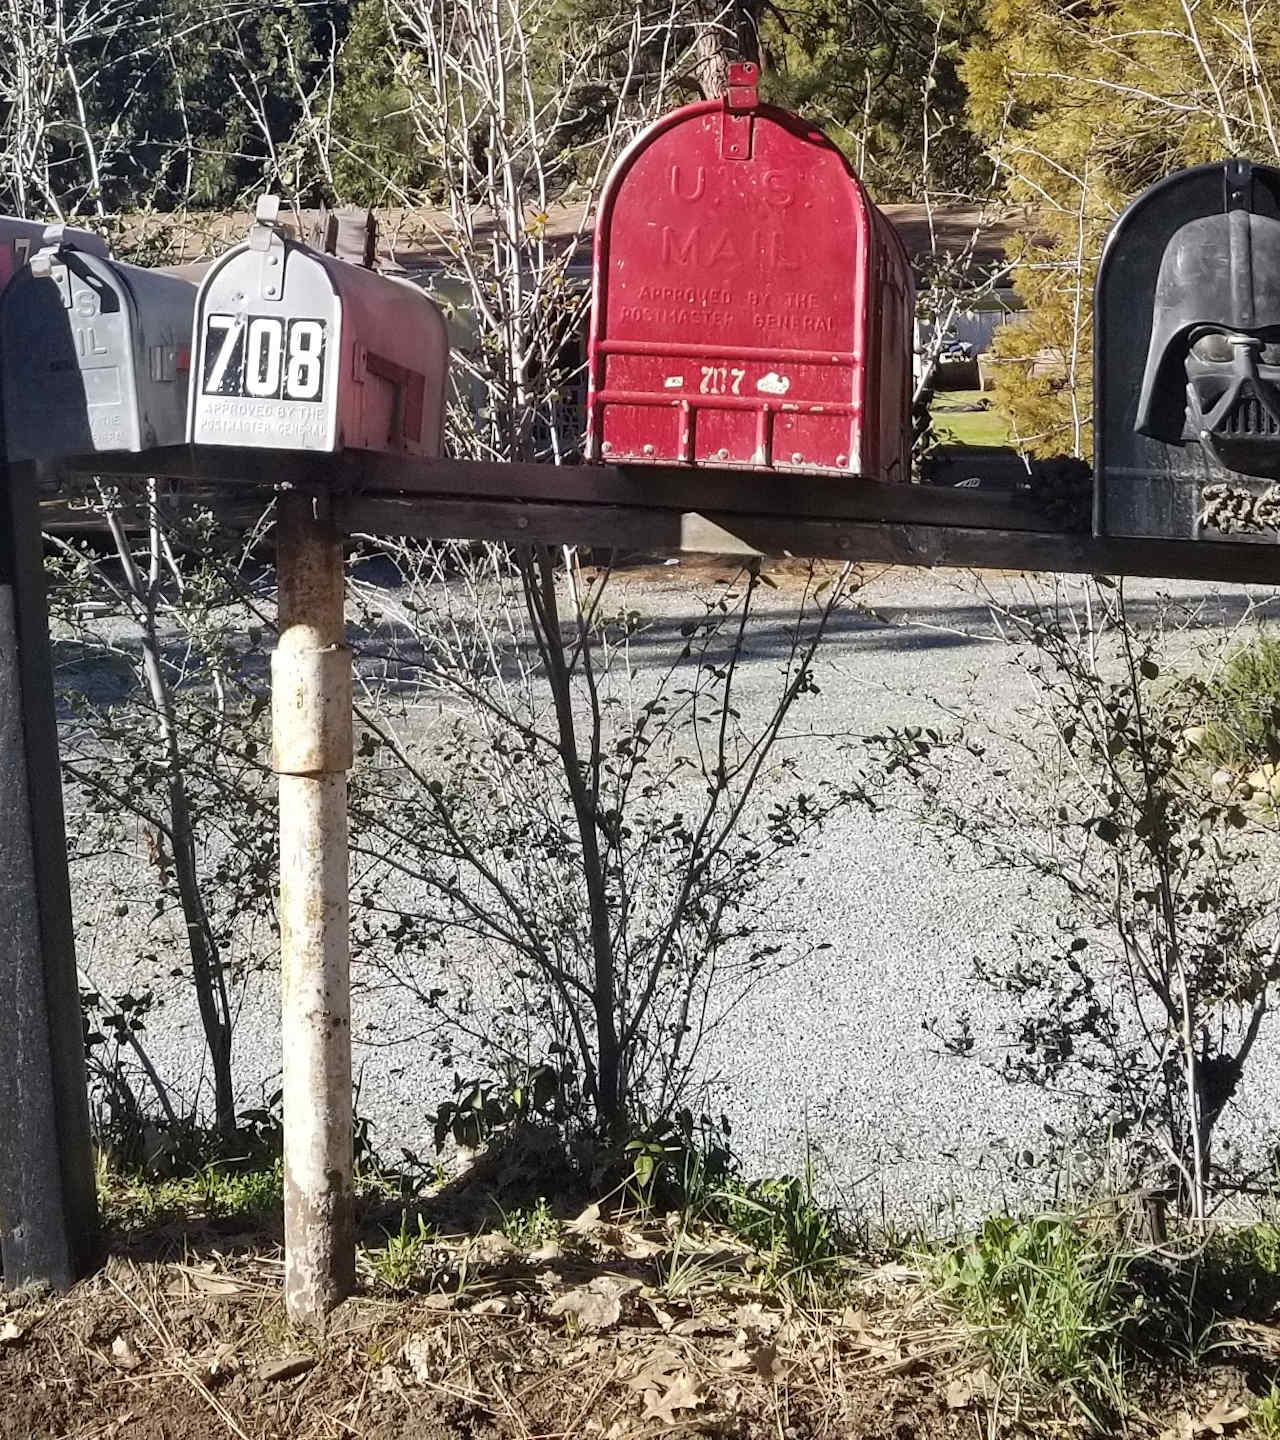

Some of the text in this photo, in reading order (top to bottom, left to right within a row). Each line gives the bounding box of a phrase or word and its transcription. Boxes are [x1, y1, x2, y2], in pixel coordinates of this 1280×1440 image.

[660, 225, 801, 269] MAIL
[639, 286, 819, 309] APPROVED BY THE
[621, 306, 834, 333] POSTMASTER GENERAL
[206, 315, 323, 399] 708
